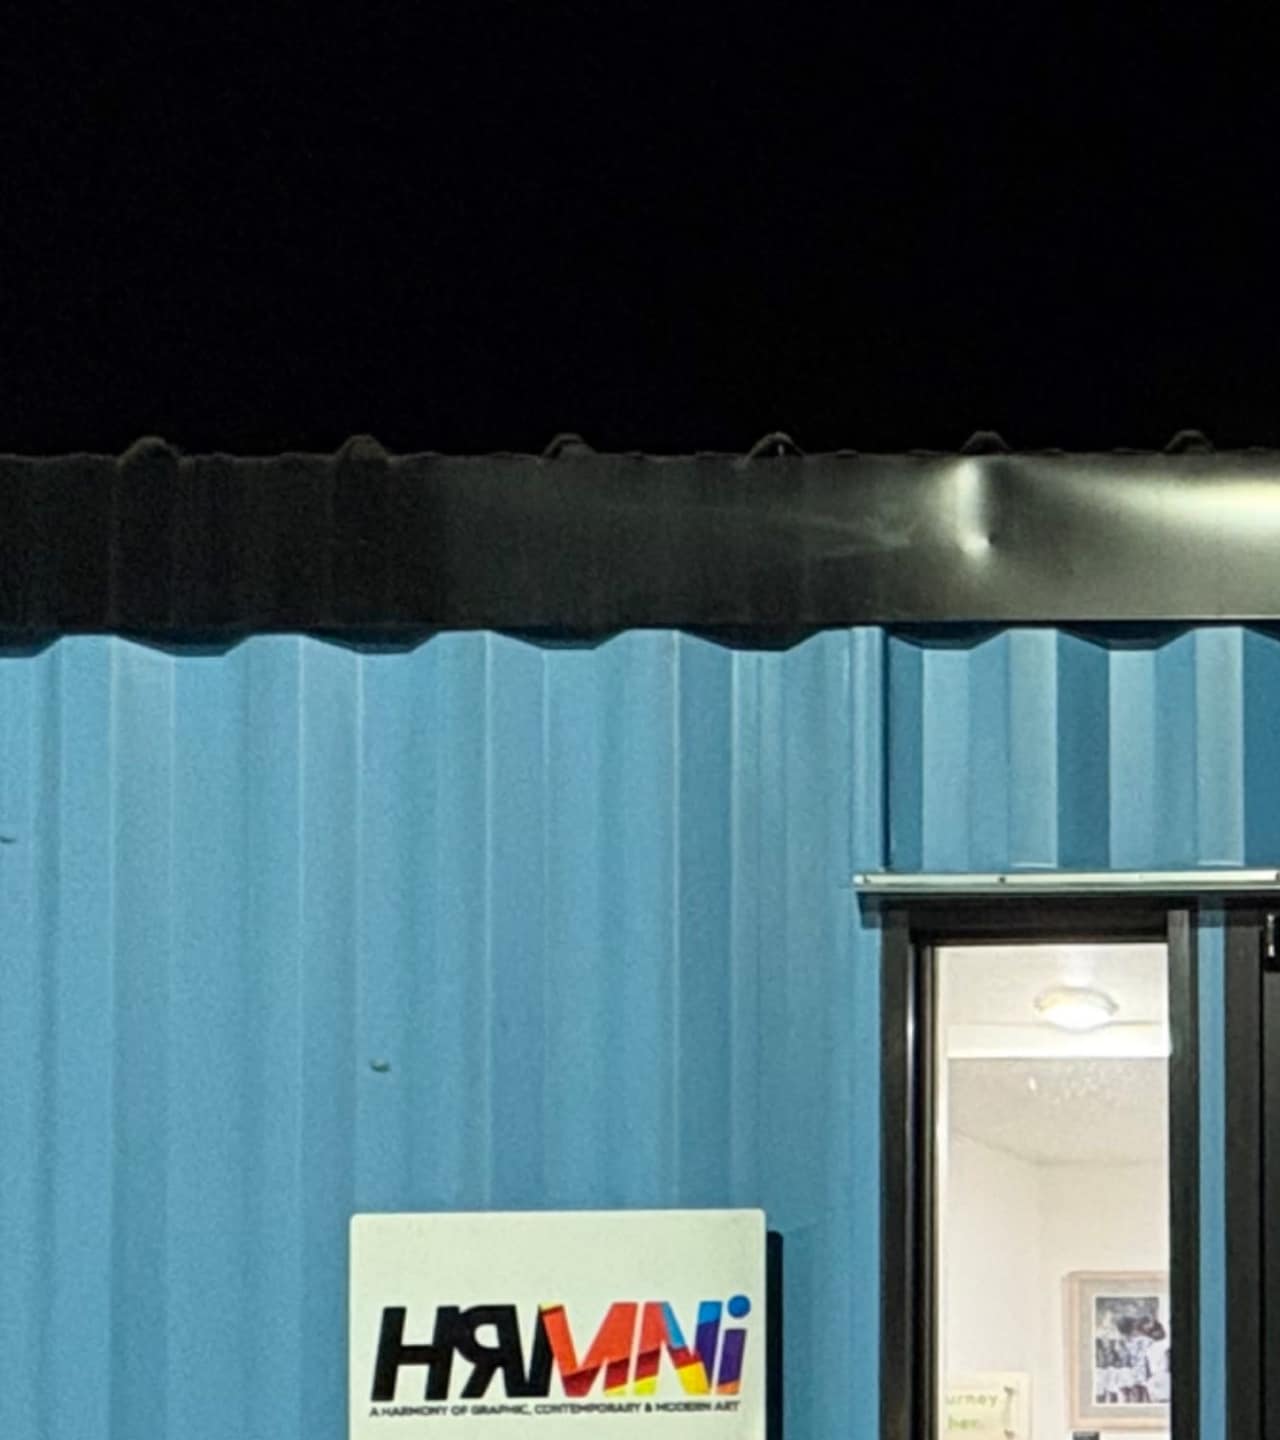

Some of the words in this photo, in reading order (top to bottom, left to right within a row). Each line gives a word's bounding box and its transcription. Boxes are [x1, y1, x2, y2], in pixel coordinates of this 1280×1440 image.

[370, 1406, 380, 1418] A
[382, 1405, 447, 1417] HARMONY
[451, 1404, 468, 1416] OF
[471, 1403, 532, 1416] GRAPHIC,
[534, 1402, 641, 1415] CONTEMPORARY
[644, 1402, 653, 1413] &
[656, 1401, 711, 1414] MODERN
[714, 1400, 741, 1412] ART
